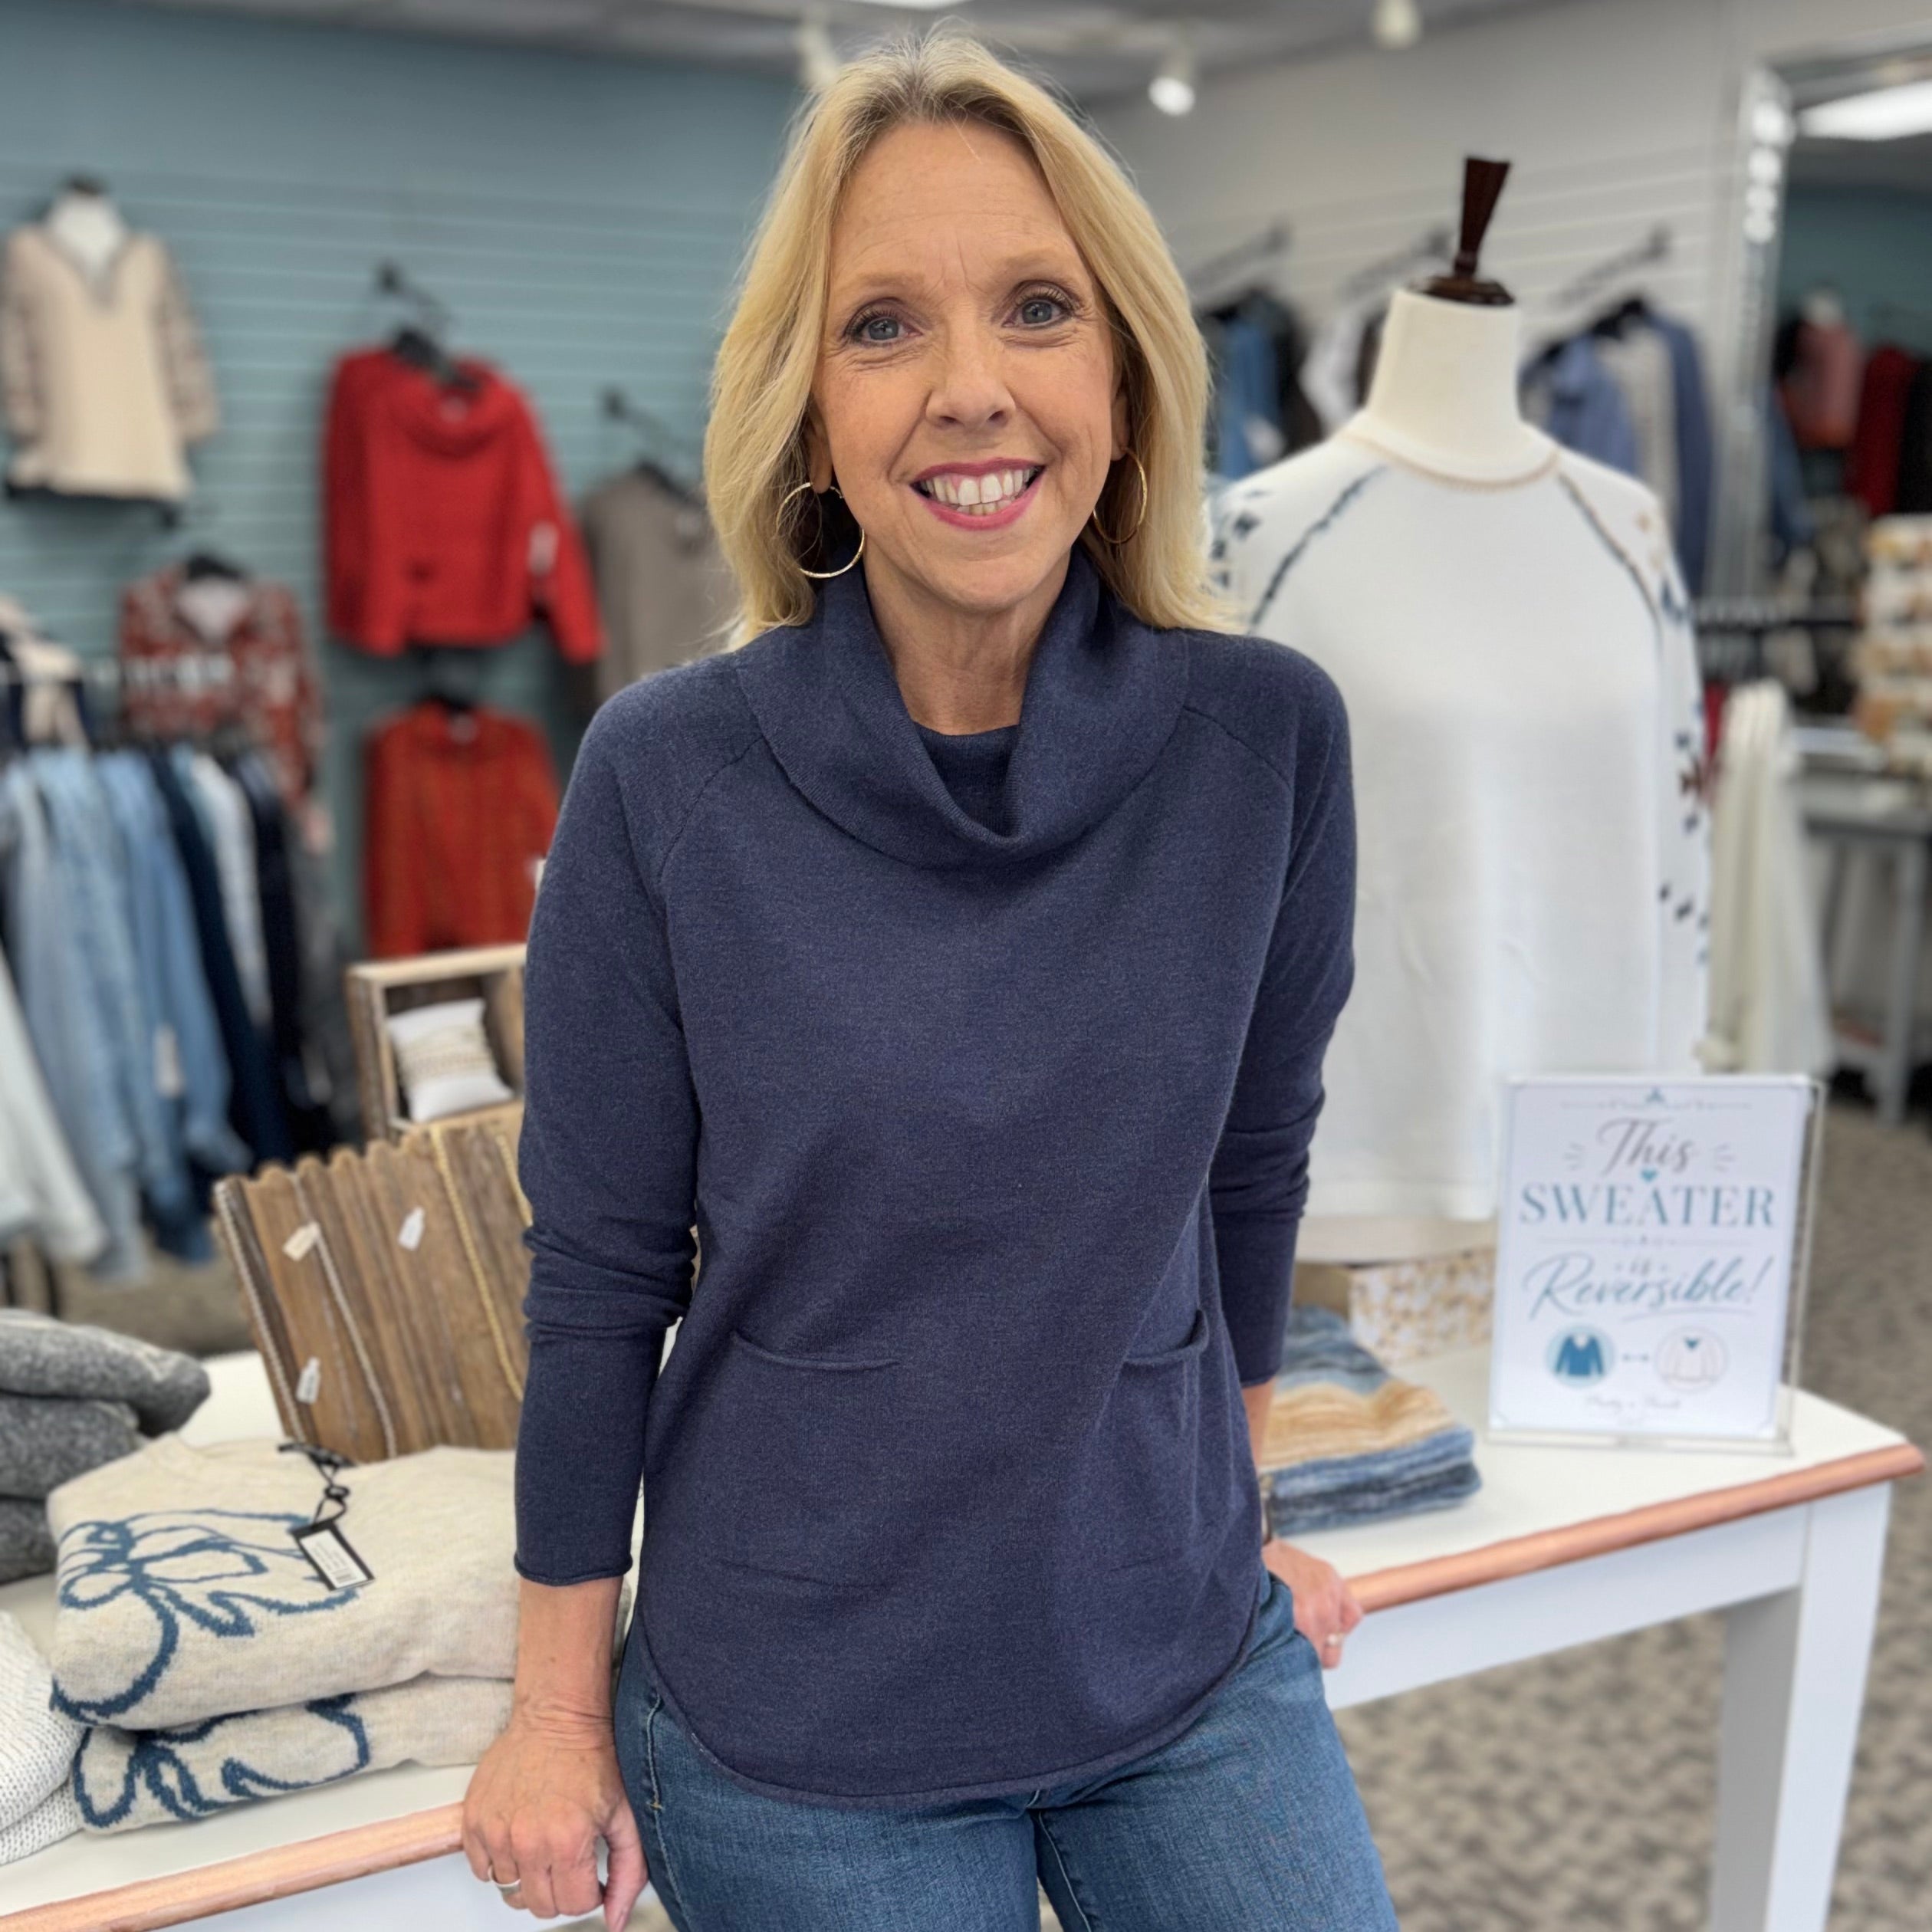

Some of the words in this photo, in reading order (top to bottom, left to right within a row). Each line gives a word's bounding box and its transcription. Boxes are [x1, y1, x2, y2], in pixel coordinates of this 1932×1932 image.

[1597, 1117, 1694, 1177] This
[1520, 1183, 1775, 1227] SWEATER
[1521, 1250, 1776, 1321] Reversible!
